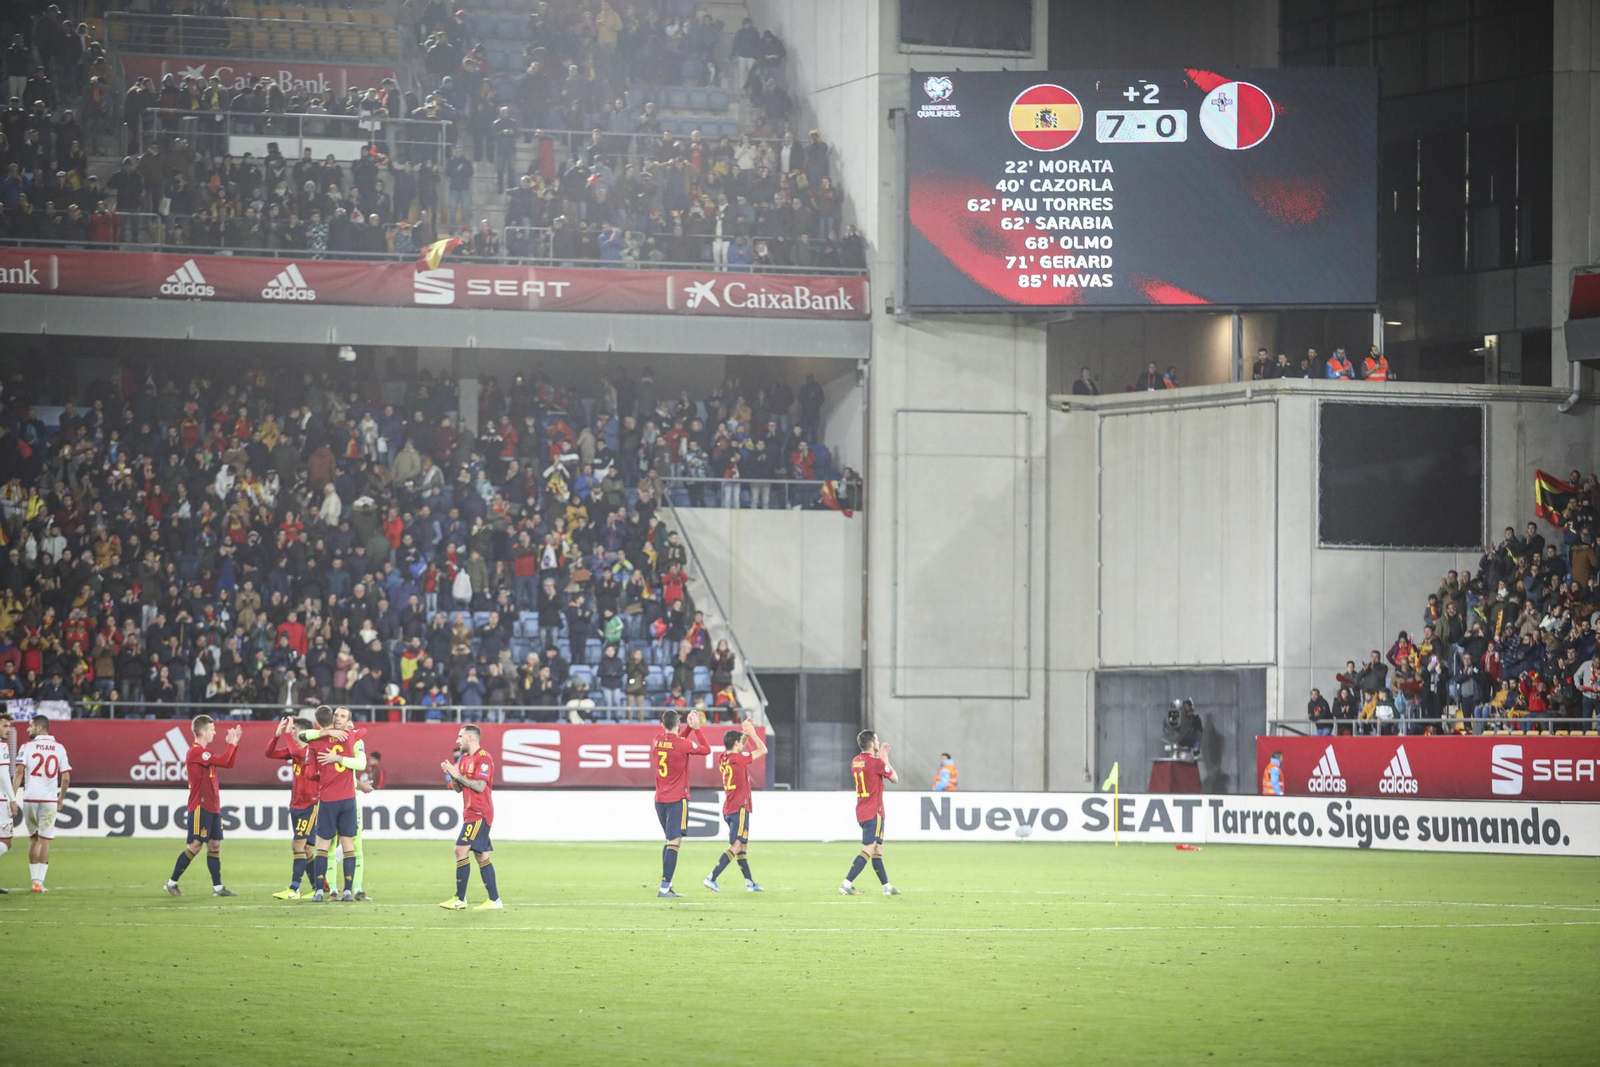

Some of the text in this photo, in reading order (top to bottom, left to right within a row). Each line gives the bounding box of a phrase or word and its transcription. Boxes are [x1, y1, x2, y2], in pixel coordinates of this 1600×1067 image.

[1123, 84, 1159, 104] +2
[1005, 160, 1114, 174] 22' MORATA
[995, 179, 1114, 192] 40' CAZORLA
[967, 198, 1114, 212] 62' PAU TORRES
[1001, 216, 1114, 230] 62' SARABIA
[1025, 236, 1113, 250] 68' OLMO
[1005, 255, 1113, 269] 71' GERARD
[160, 281, 216, 297] adidas
[466, 279, 570, 298] SEAT
[1018, 274, 1114, 288] 85' NAVAS
[262, 285, 316, 301] adidas
[723, 282, 854, 311] CaixaBank
[31, 752, 59, 778] 20
[578, 743, 726, 769] SET
[657, 751, 669, 778] 3
[130, 760, 188, 781] adid
[719, 764, 737, 790] 22
[1532, 759, 1600, 781] SEA
[853, 771, 870, 798] 11
[1308, 774, 1346, 793] adidas
[1379, 775, 1418, 794] adidas
[920, 796, 1206, 833] Nuevo SEAT
[1208, 799, 1570, 849] Tarraco. Sigue sumando.
[296, 818, 308, 832] 19
[465, 824, 473, 837] 9
